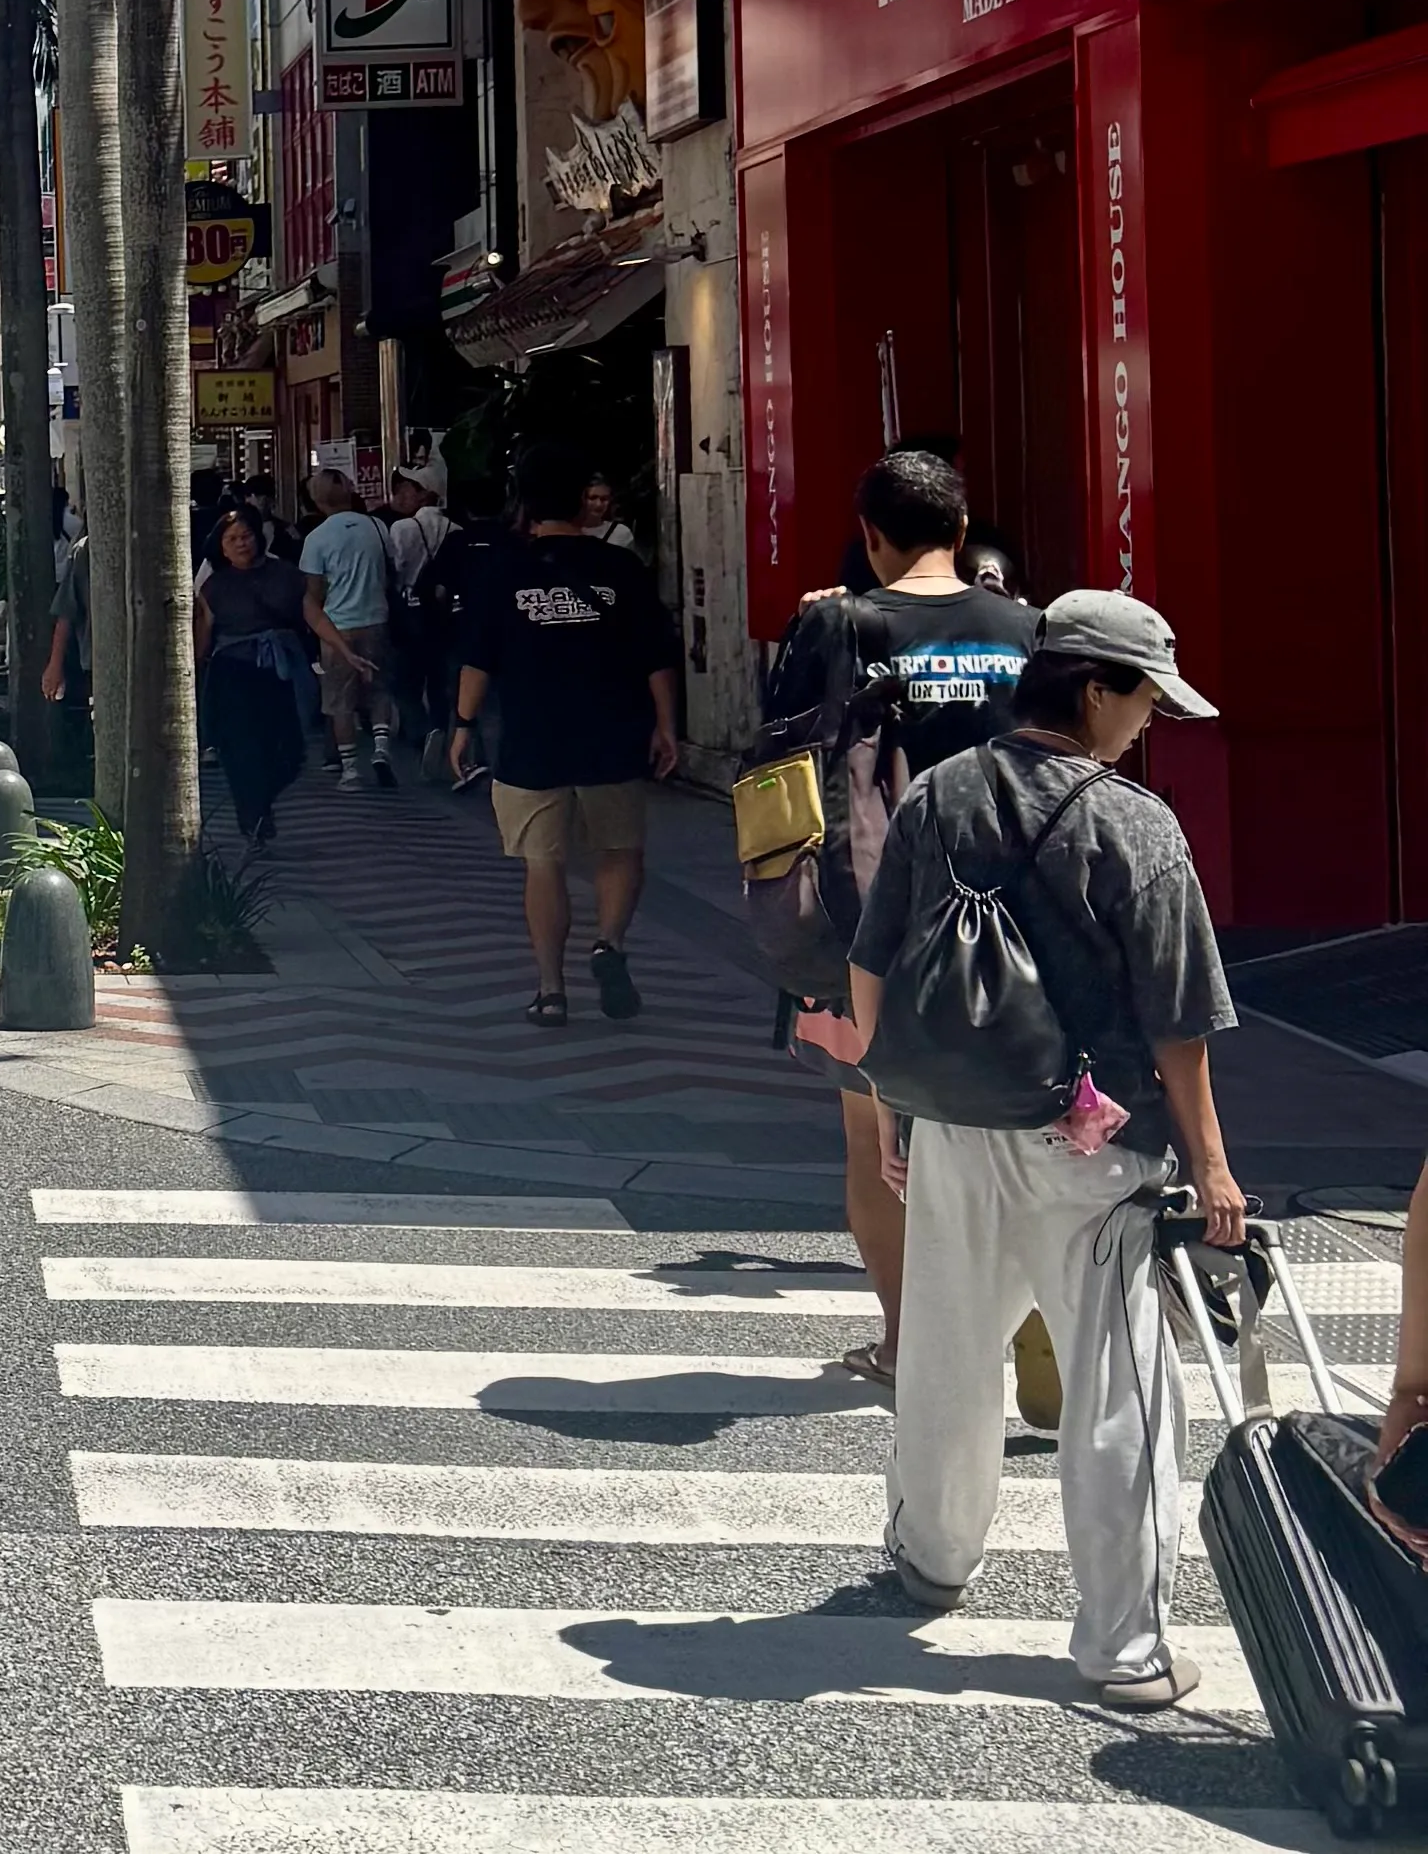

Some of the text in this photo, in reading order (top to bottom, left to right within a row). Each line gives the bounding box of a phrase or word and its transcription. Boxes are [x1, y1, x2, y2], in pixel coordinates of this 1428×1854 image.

[326, 66, 453, 96] たばこ 酒 ATM
[1107, 120, 1127, 343] HOUSE
[935, 681, 982, 699] TOUR
